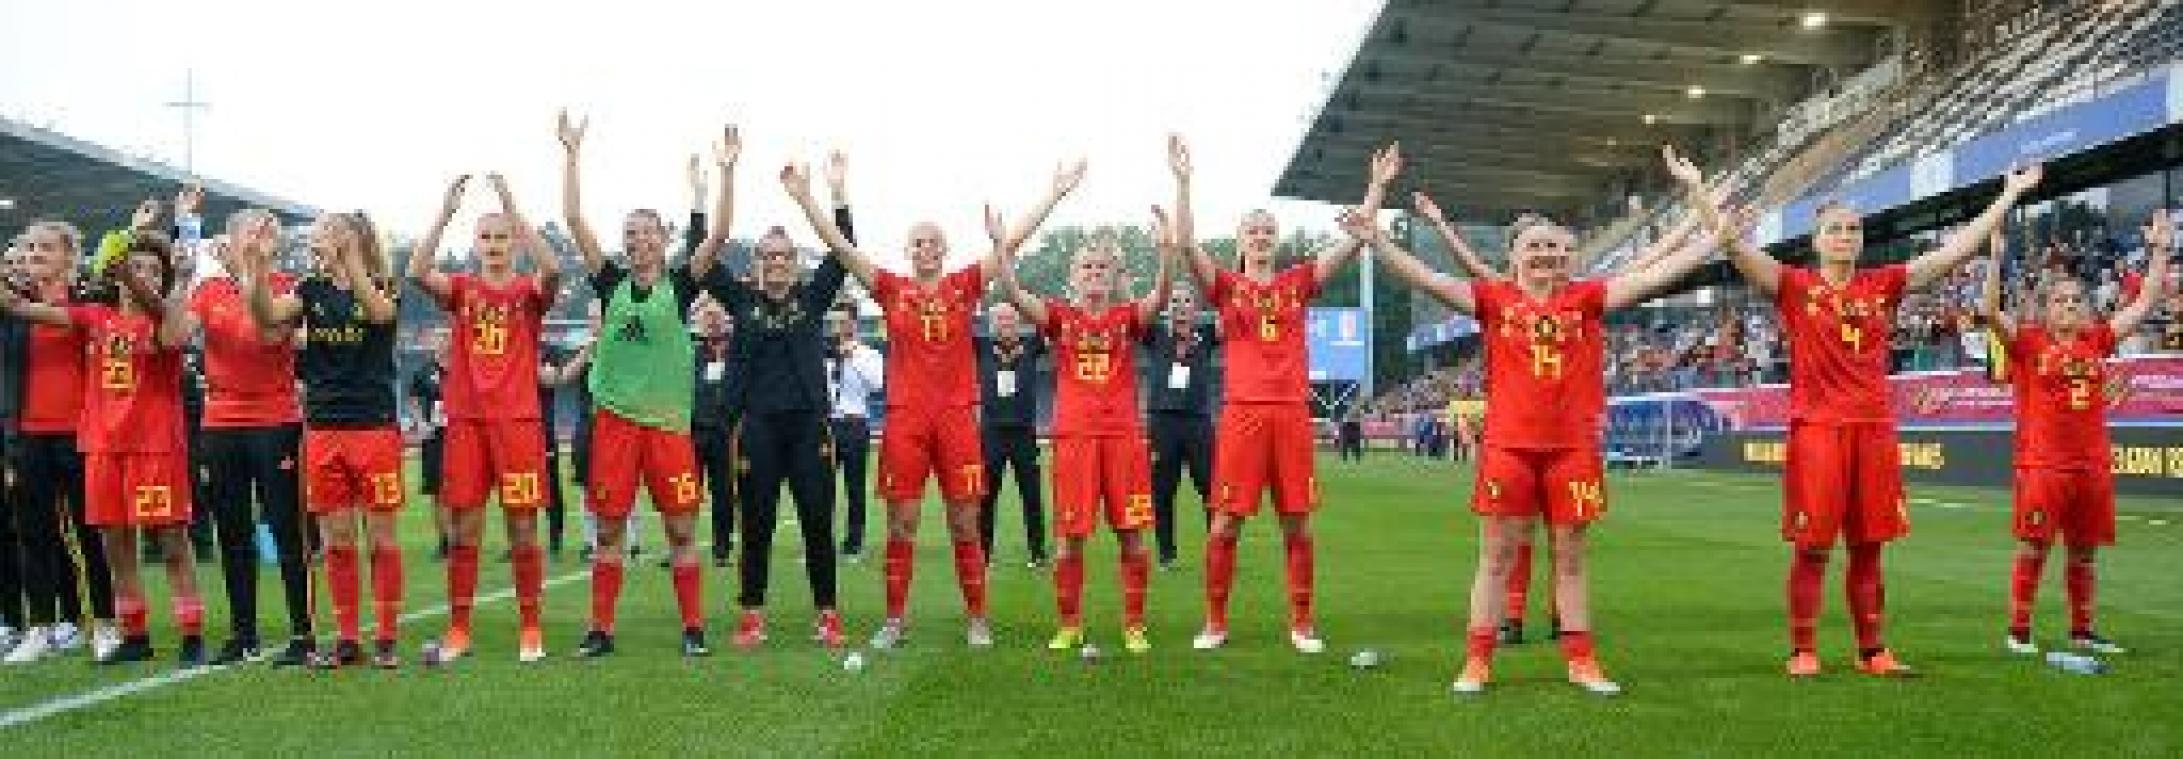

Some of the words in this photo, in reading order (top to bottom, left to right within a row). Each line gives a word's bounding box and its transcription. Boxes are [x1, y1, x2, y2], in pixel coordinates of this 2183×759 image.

[1261, 315, 1279, 341] 6
[1841, 323, 1861, 354] 4
[1078, 353, 1110, 381] 22
[1530, 345, 1562, 380] 14
[2071, 379, 2091, 410] 2
[135, 485, 172, 517] 23
